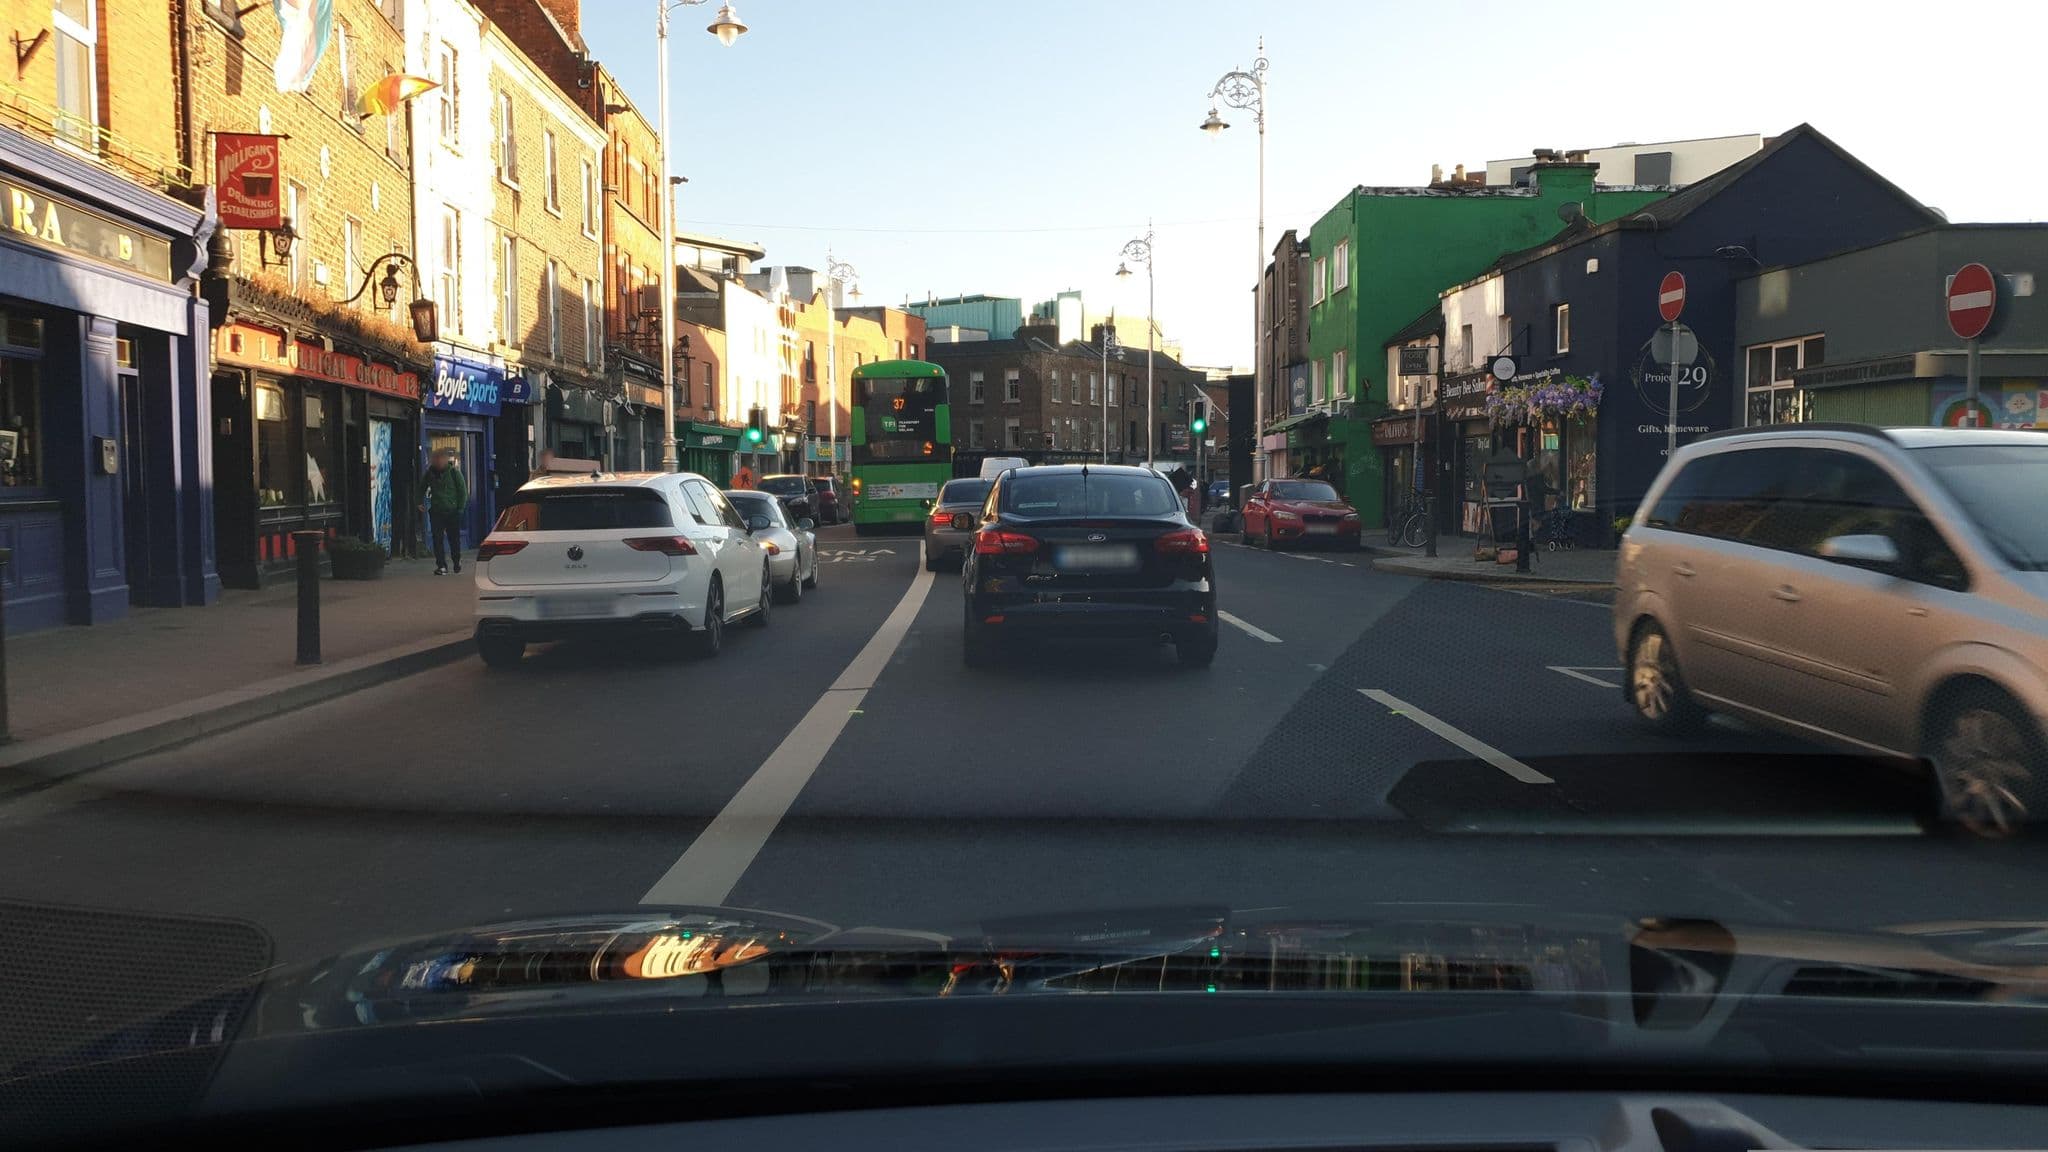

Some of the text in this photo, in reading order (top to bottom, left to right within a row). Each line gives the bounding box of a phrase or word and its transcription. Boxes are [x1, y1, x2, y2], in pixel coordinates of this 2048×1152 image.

[227, 186, 274, 208] DRINKING
[0, 187, 66, 247] RA
[436, 368, 498, 408] BoyleSports
[1678, 366, 1707, 389] 29
[893, 398, 905, 410] 37
[1638, 424, 1662, 434] Gifts,
